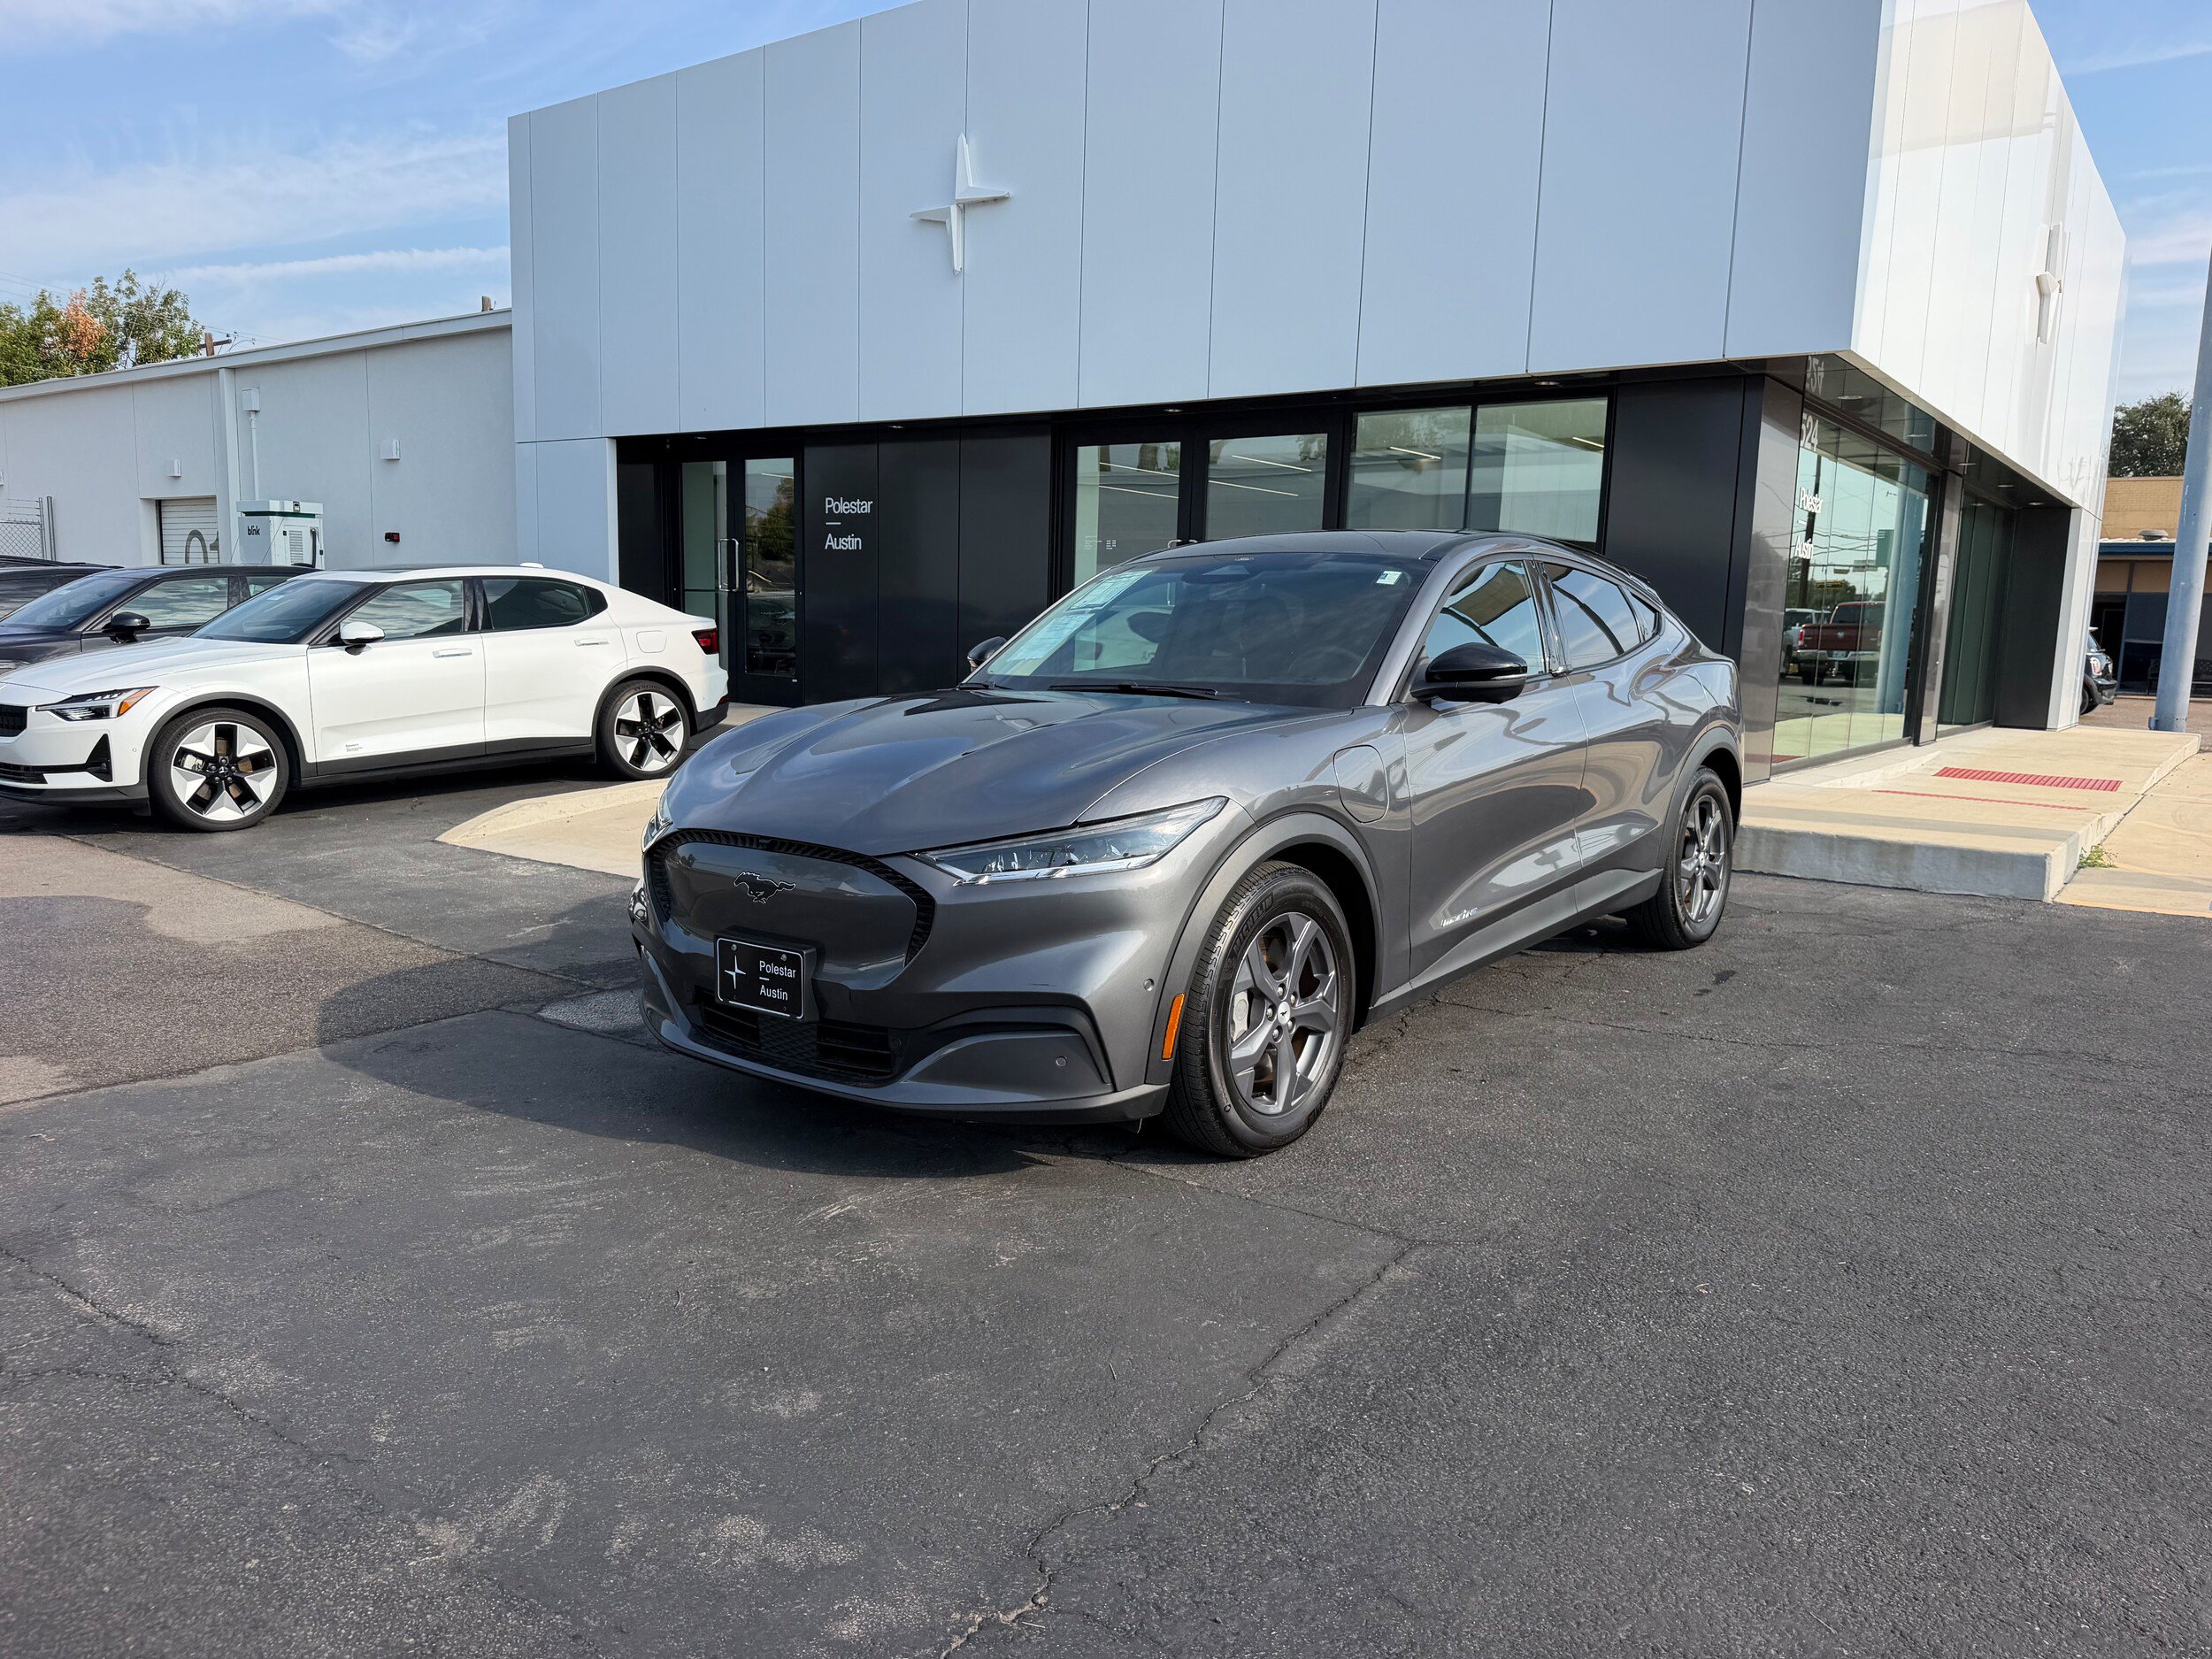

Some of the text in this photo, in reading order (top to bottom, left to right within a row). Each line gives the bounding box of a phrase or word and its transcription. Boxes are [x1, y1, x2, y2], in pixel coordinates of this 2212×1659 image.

[825, 496, 873, 514] Polestar
[247, 526, 260, 535] blink
[825, 533, 862, 550] Austin
[1233, 895, 1273, 953] MICHELIN
[759, 960, 795, 979] Polestar
[759, 984, 788, 1001] Austin
